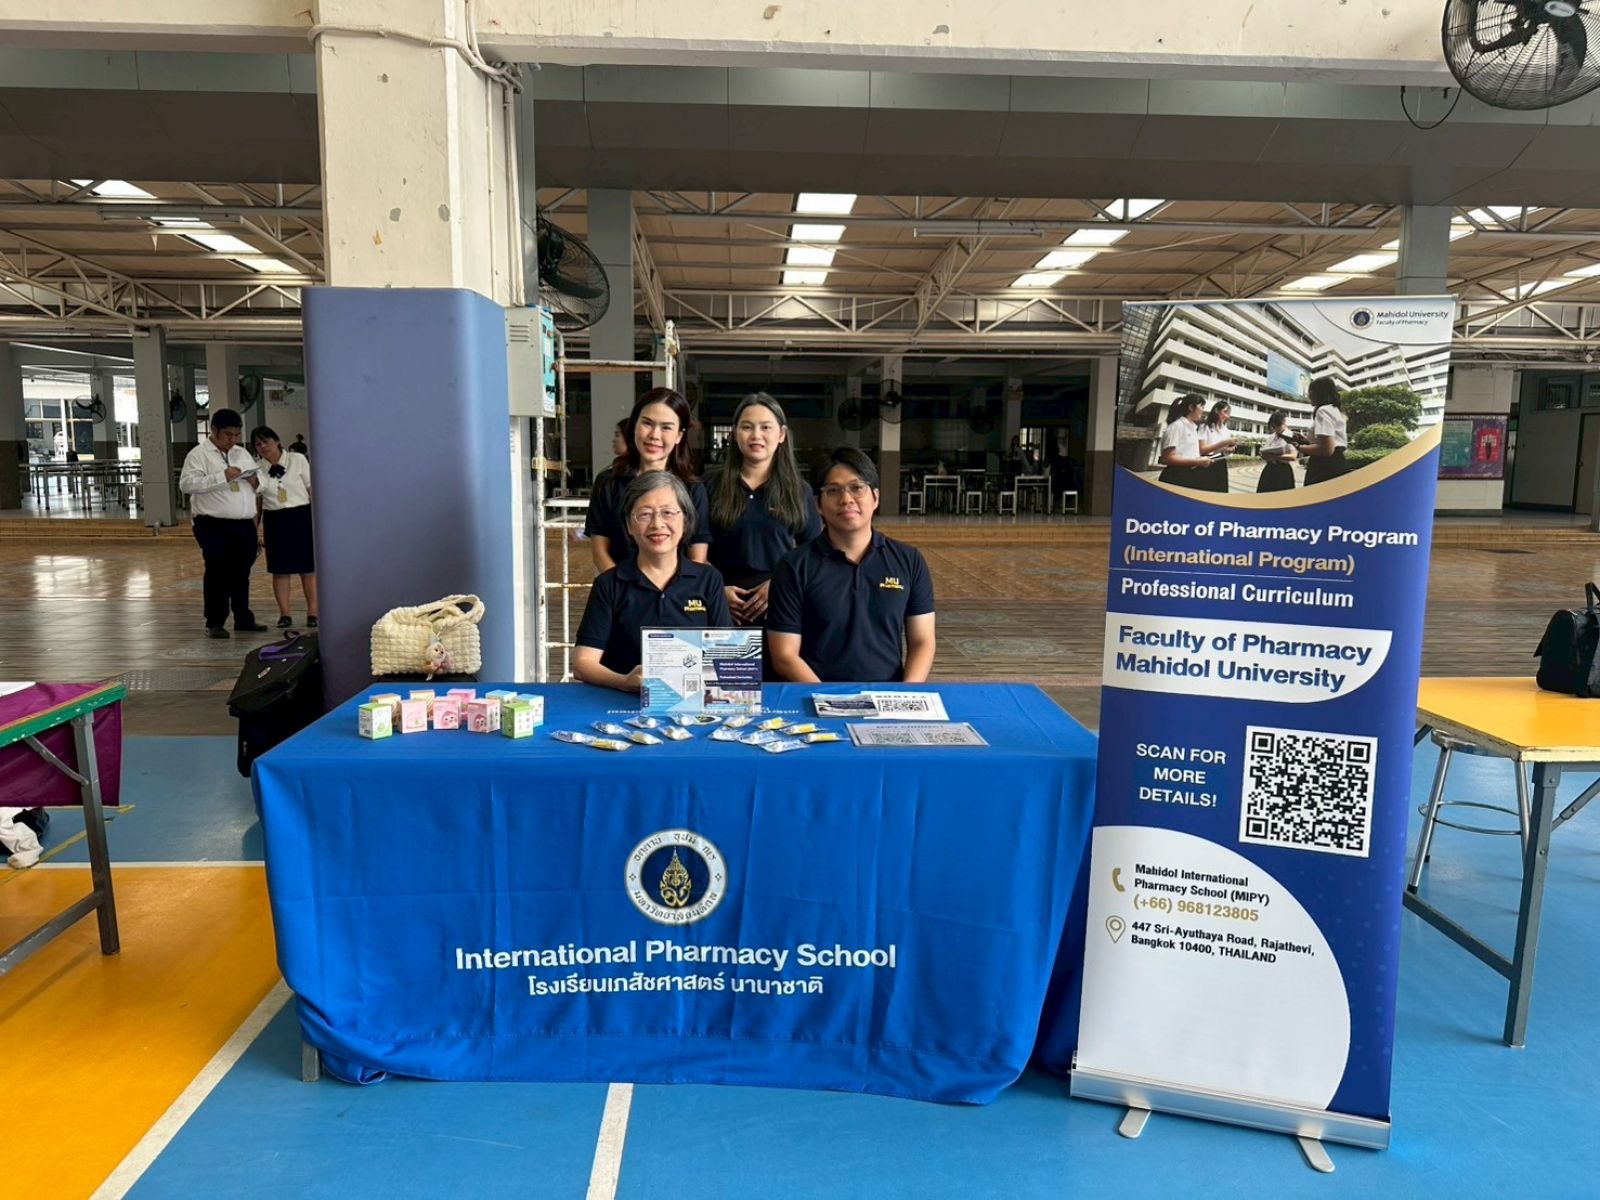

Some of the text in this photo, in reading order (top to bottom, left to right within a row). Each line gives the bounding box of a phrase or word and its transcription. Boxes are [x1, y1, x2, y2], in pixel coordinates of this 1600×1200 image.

[1376, 310, 1449, 319] Mahidol University
[1125, 518, 1418, 548] Doctor of Pharmacy Program
[1124, 545, 1355, 575] (International Program)
[885, 576, 900, 585] MU
[1121, 577, 1353, 608] Professional Curriculum
[688, 599, 702, 607] MU
[1119, 625, 1372, 666] Faculty of Pharmacy
[1116, 652, 1346, 693] Mahidol University
[1136, 743, 1226, 765] SCAN FOR
[1153, 767, 1206, 784] MORE
[1139, 786, 1217, 807] DETAILS!
[1135, 864, 1249, 887] Mahidol International
[1134, 878, 1270, 907] Pharmacy School (MIPY)
[1133, 894, 1259, 922] (+66) 968123805
[1131, 921, 1315, 956] 447 Sri-Ayuthaya Road, Rajathevi,
[1131, 935, 1277, 963] Bangkok 10400, THAILAND
[455, 939, 896, 971] International Pharmacy School
[528, 971, 824, 996] โรงเรียนเภสัชศาสตร์ นานาชาติ
